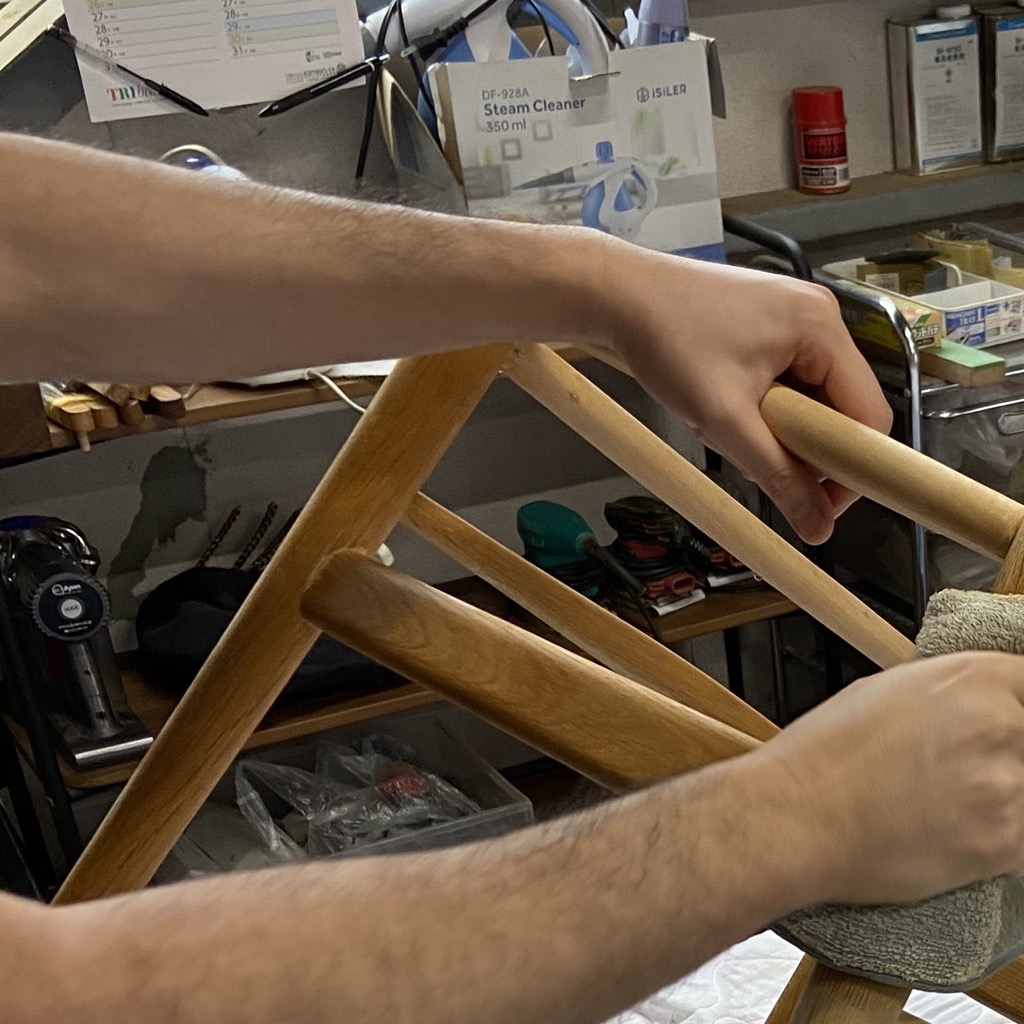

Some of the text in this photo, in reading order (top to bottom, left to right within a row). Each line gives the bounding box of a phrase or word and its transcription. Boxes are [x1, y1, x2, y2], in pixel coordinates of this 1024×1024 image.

[91, 12, 103, 22] 27
[225, 10, 236, 19] 28
[95, 25, 107, 35] 28
[228, 22, 238, 32] 29
[98, 37, 110, 47] 29
[232, 46, 243, 56] 31
[481, 87, 530, 101] DF-928A
[484, 98, 586, 116] Steam Cleaner
[486, 119, 527, 133] 350 ml
